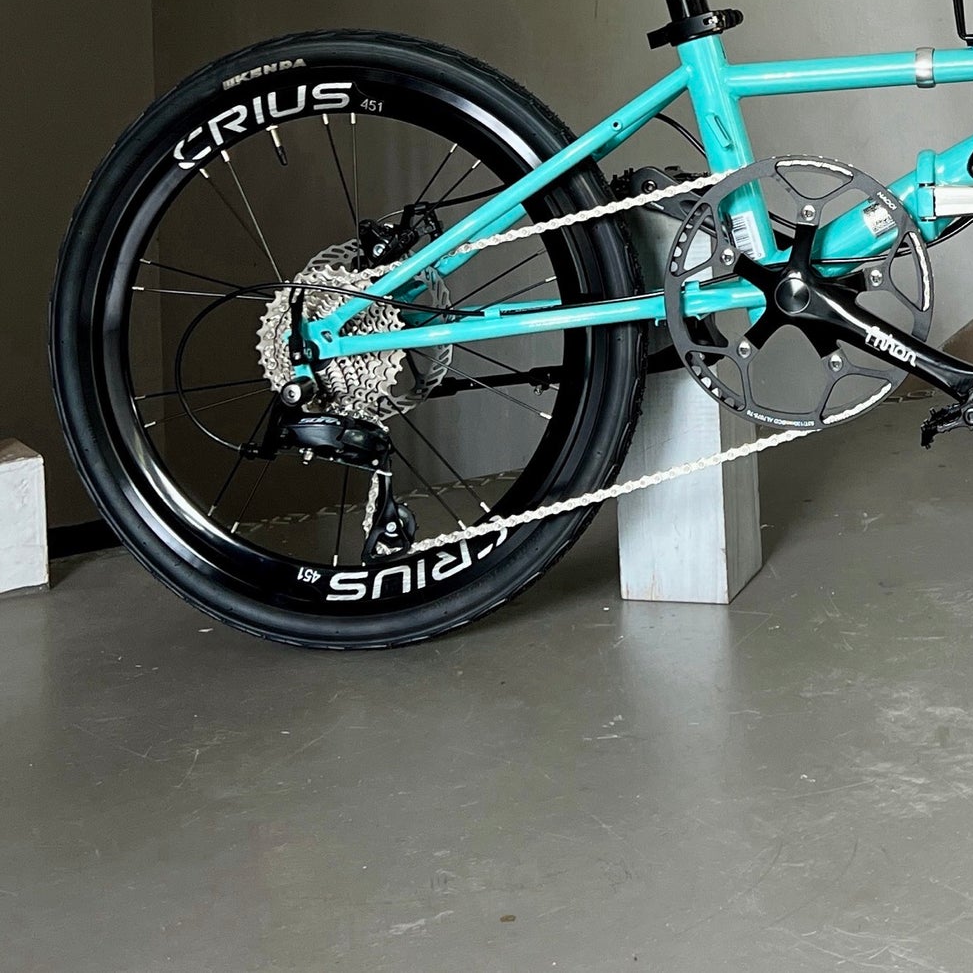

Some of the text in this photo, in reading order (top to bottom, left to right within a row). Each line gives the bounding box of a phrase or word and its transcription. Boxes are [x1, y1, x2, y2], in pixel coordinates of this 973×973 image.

[229, 58, 307, 88] KENDA
[173, 82, 385, 170] CRIUS 451
[296, 566, 322, 584] 451
